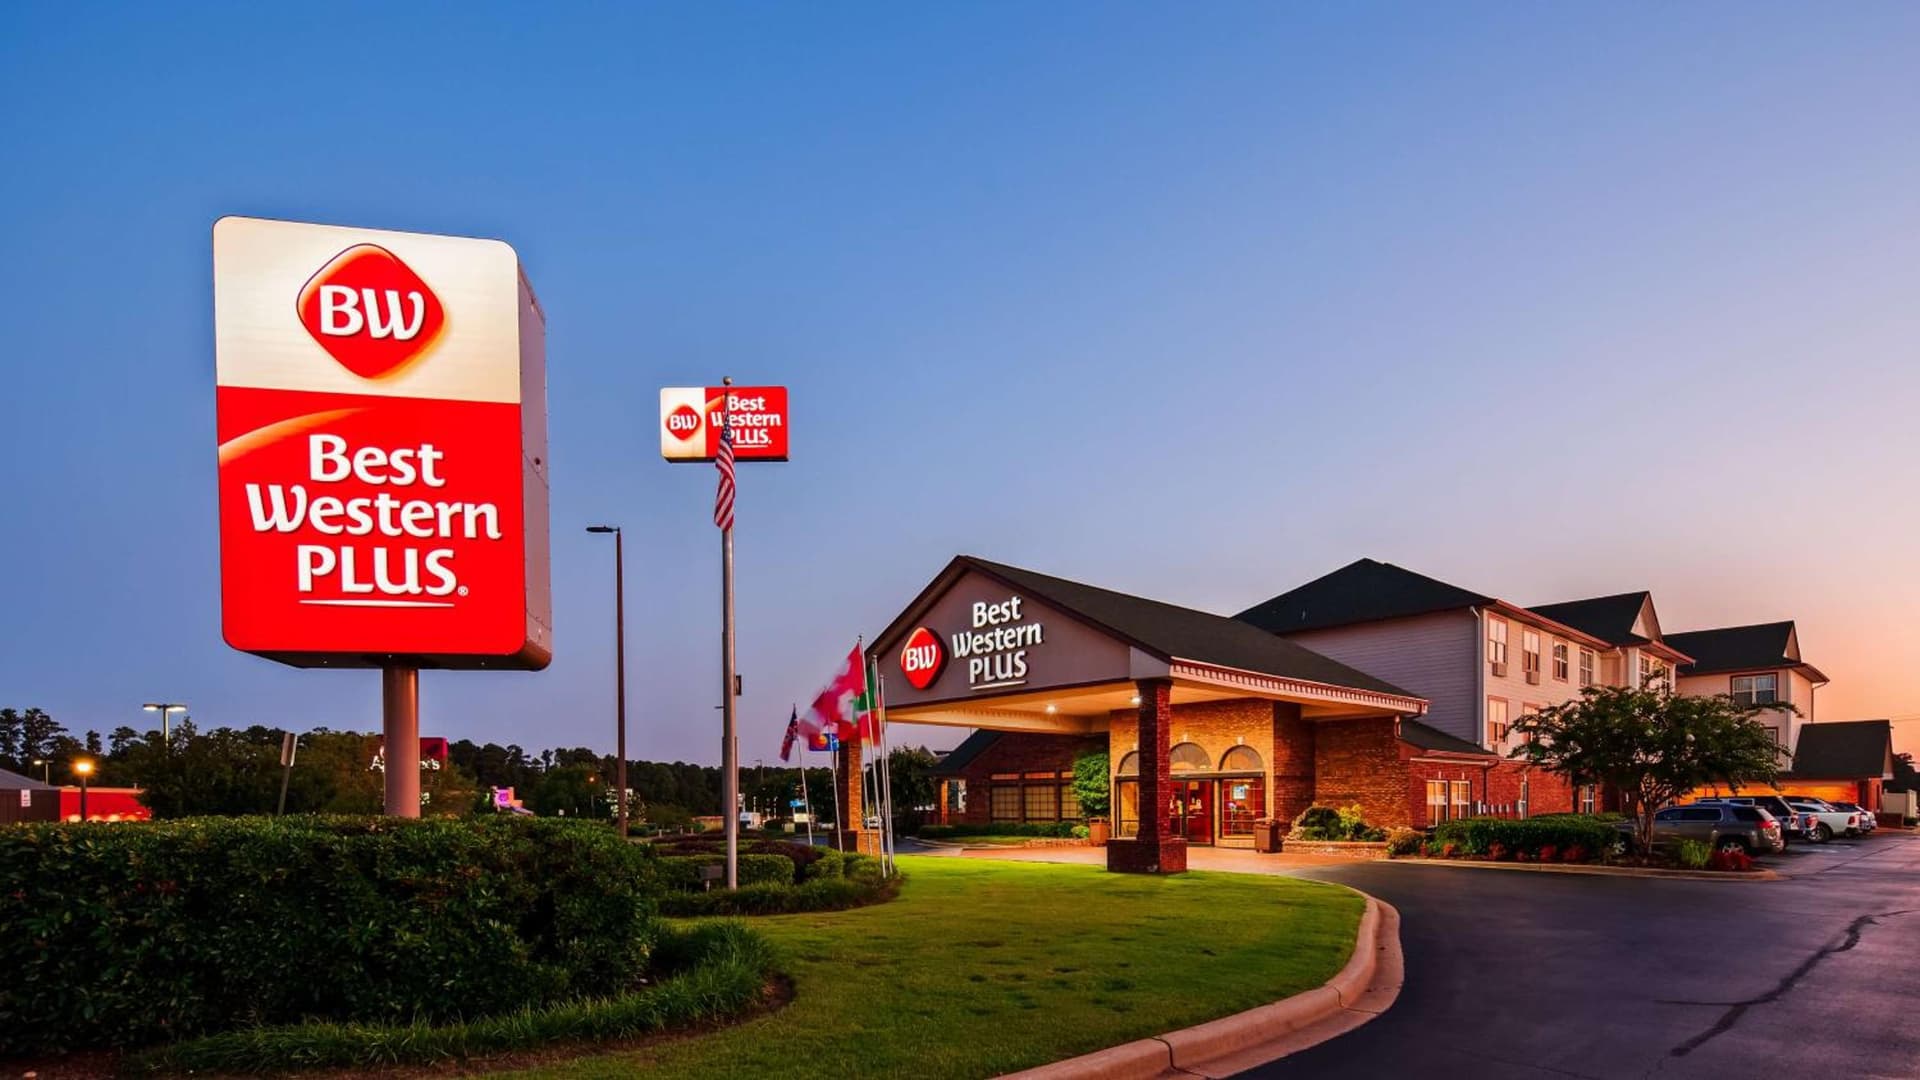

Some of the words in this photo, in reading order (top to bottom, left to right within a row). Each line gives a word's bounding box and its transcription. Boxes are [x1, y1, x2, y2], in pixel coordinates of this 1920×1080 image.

[320, 285, 425, 340] BW
[728, 395, 766, 411] Best
[669, 414, 697, 430] BW
[309, 434, 445, 487] Best
[246, 483, 502, 539] Western
[972, 596, 1022, 628] Best
[952, 622, 1042, 658] Western
[905, 644, 937, 672] BW
[969, 650, 1028, 684] PLUS
